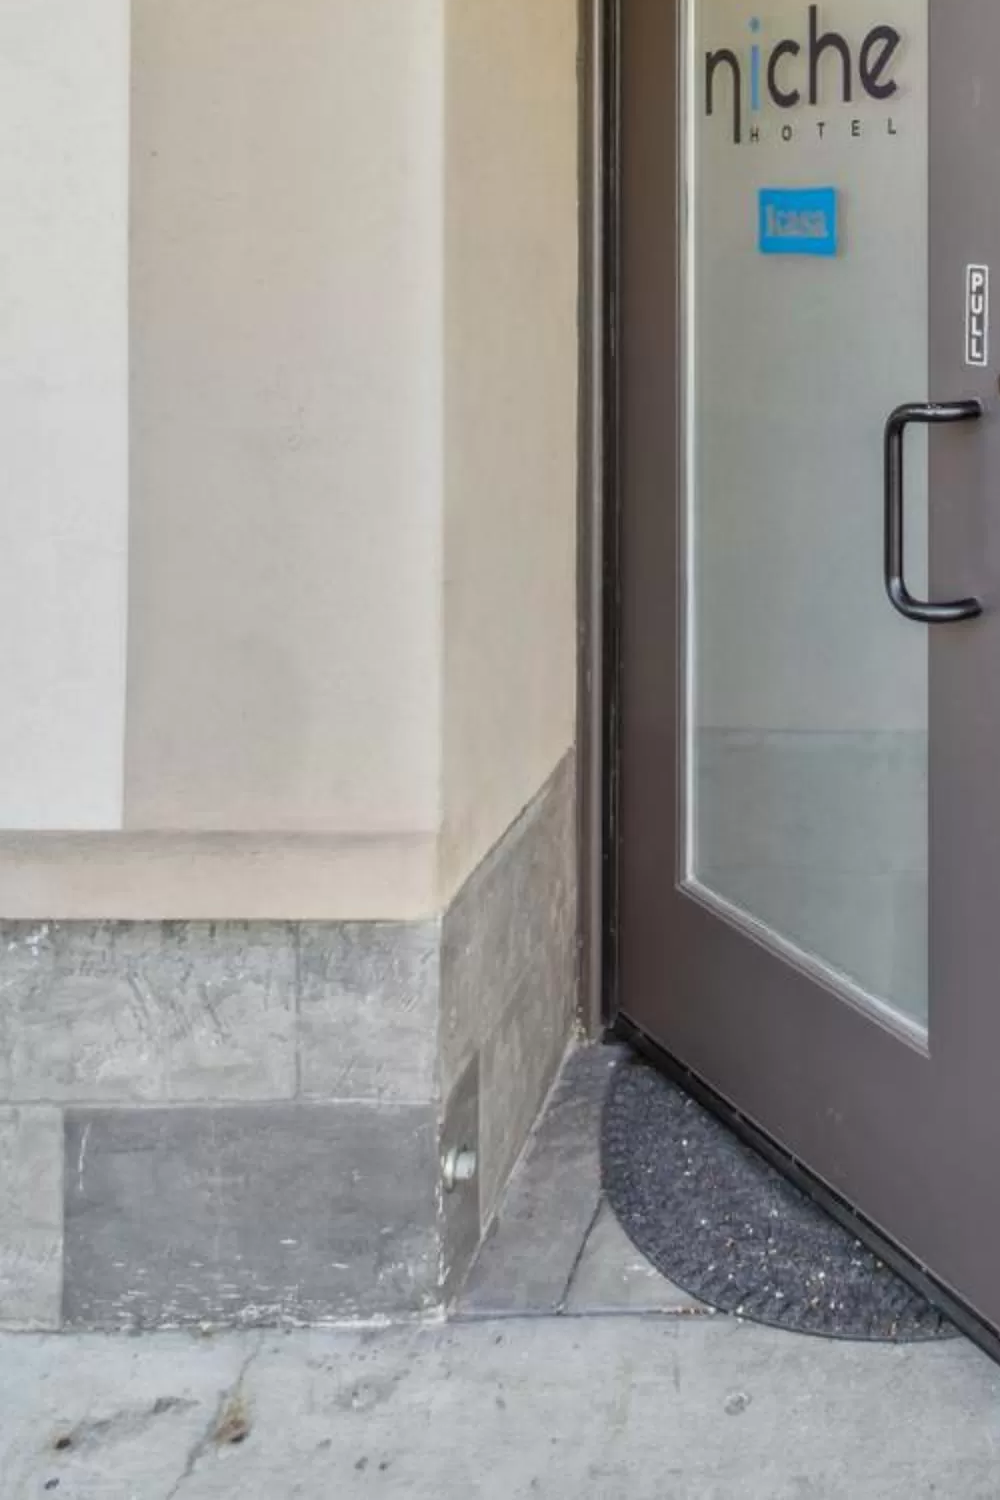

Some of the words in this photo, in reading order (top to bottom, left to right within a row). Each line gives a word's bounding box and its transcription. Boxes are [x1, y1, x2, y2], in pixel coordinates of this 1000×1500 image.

[705, 4, 901, 144] niche
[749, 117, 897, 142] HOTEL
[970, 270, 984, 360] PULL
